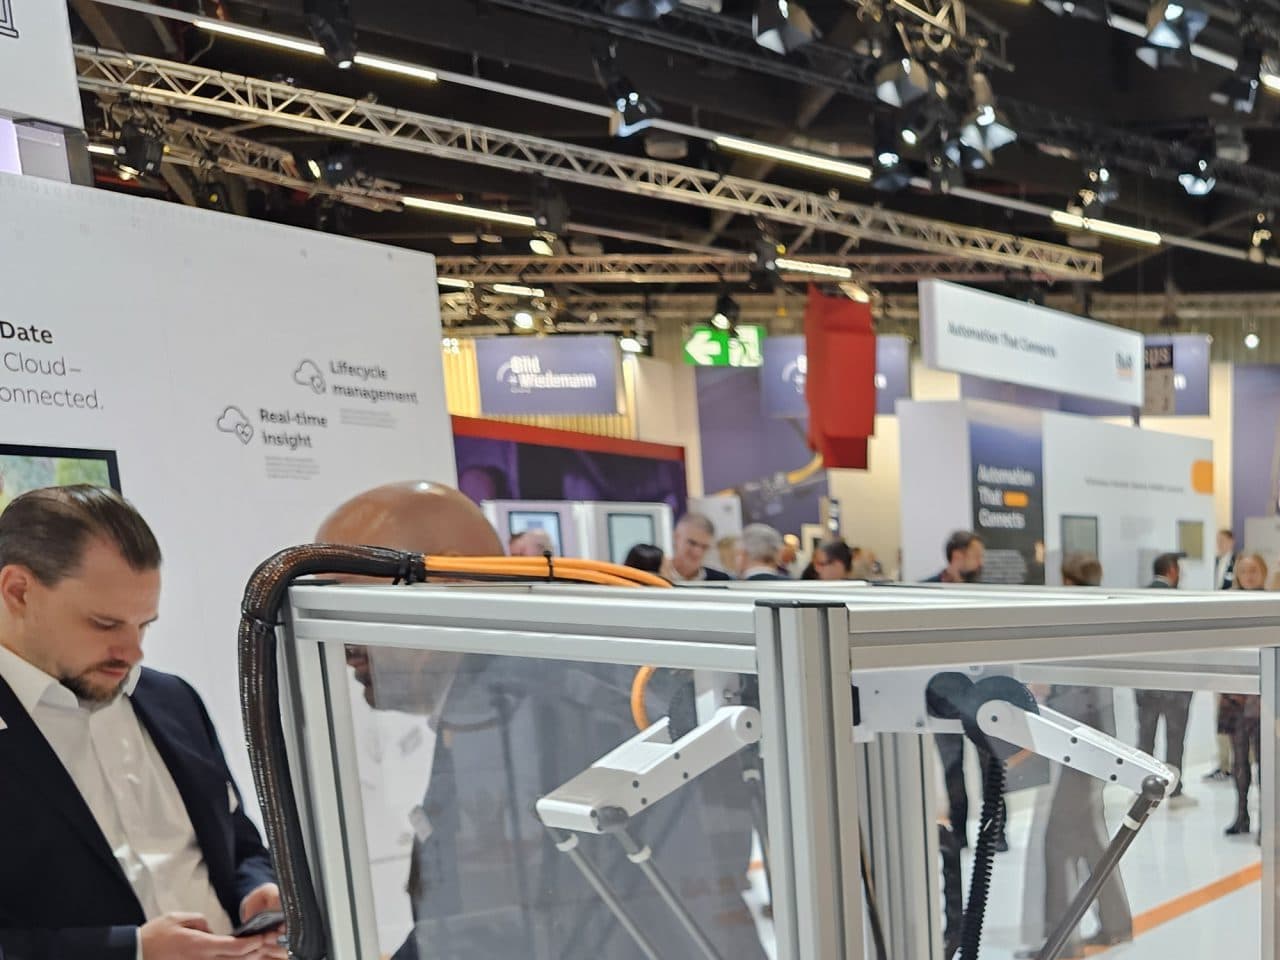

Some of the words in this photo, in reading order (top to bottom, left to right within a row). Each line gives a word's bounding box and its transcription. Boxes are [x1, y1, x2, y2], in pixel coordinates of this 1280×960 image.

[0, 321, 53, 344] Date
[329, 360, 388, 381] Lifecycle
[332, 384, 419, 404] management
